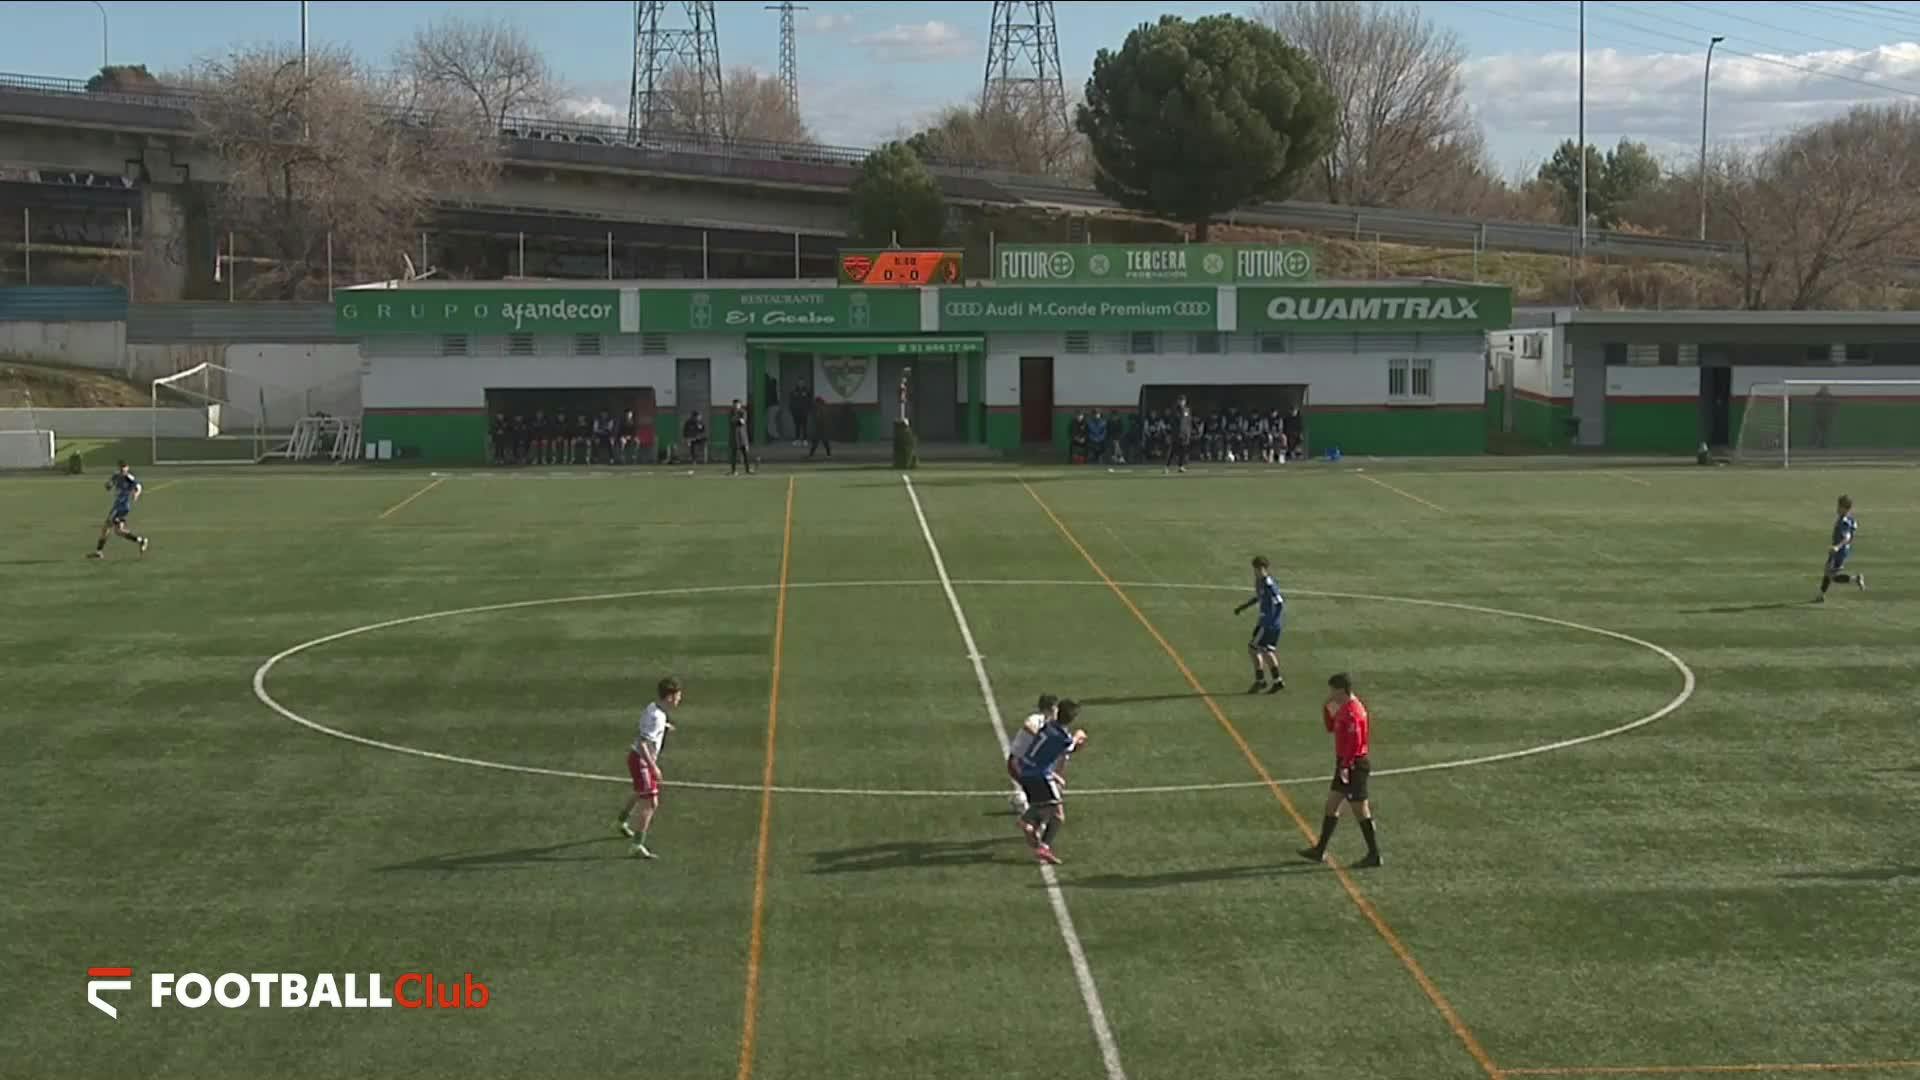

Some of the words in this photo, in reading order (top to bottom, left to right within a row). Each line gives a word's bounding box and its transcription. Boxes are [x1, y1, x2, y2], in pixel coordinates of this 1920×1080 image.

[1126, 250, 1187, 270] TERCERA
[884, 269, 893, 281] 0
[910, 269, 919, 281] 0
[740, 293, 825, 305] RESTAURANTE
[341, 303, 489, 319] GRUPO
[501, 299, 613, 329] afandecor
[985, 303, 1023, 316] Audi
[1028, 303, 1097, 316] M.Conde
[1100, 303, 1171, 316] Premium
[1266, 296, 1480, 321] QUAMTRAX
[725, 310, 756, 325] El
